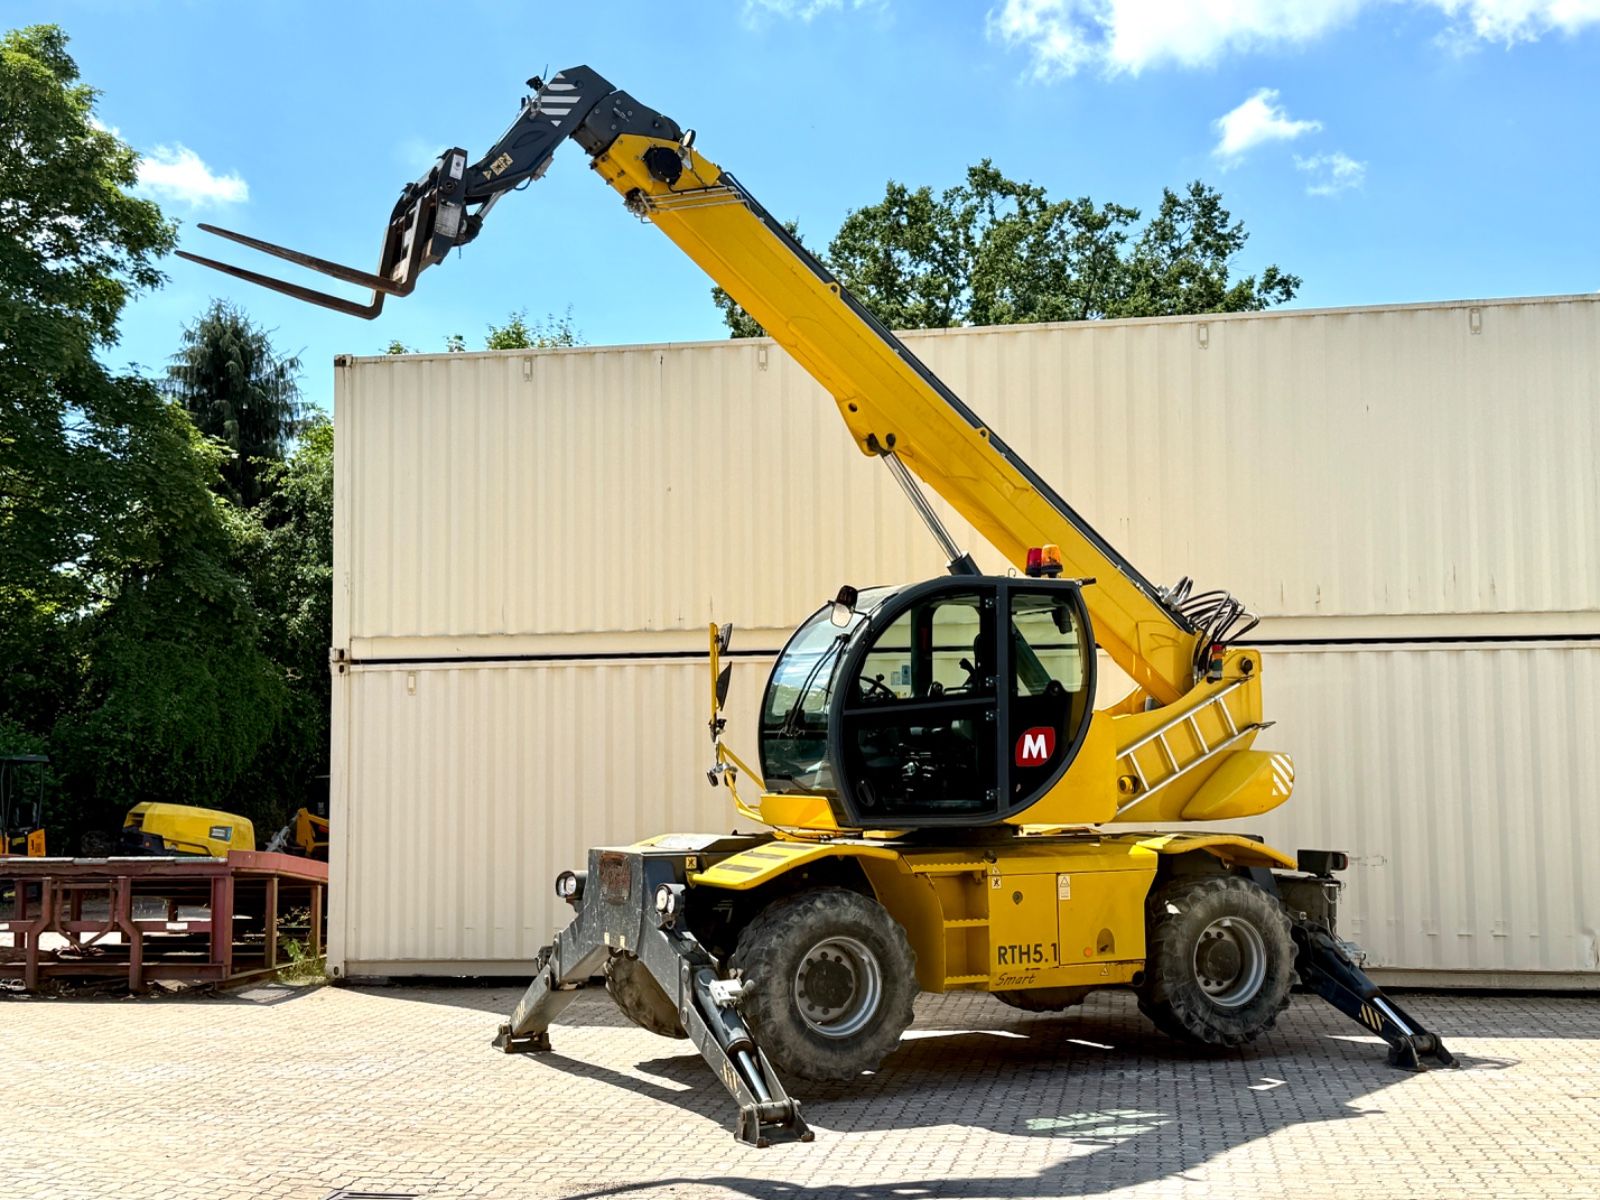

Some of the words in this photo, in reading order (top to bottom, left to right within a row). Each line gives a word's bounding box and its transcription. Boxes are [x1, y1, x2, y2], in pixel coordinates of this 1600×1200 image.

[1022, 734, 1048, 759] M
[997, 943, 1058, 965] RTH5.1
[995, 972, 1036, 986] Smart
